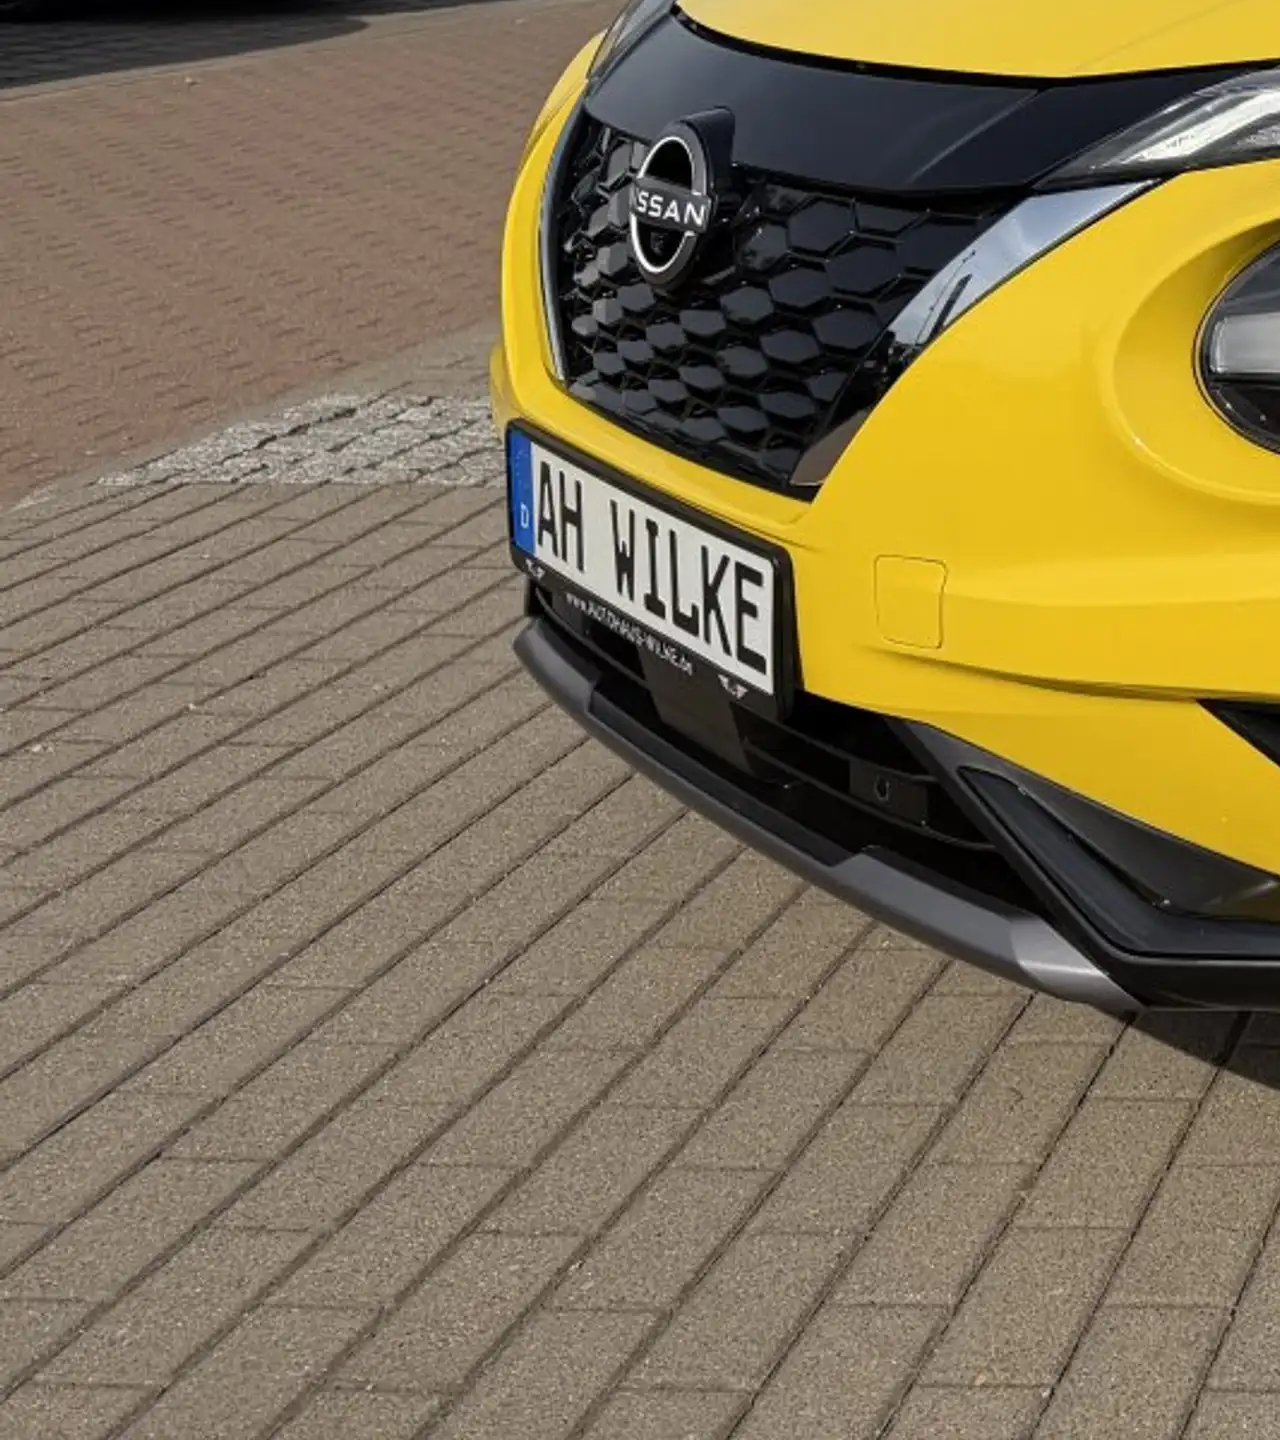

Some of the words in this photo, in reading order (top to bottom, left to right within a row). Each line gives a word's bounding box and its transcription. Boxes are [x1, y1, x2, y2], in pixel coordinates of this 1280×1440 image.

[637, 189, 706, 227] SSAN
[537, 461, 584, 573] AH
[610, 499, 767, 676] WILKE
